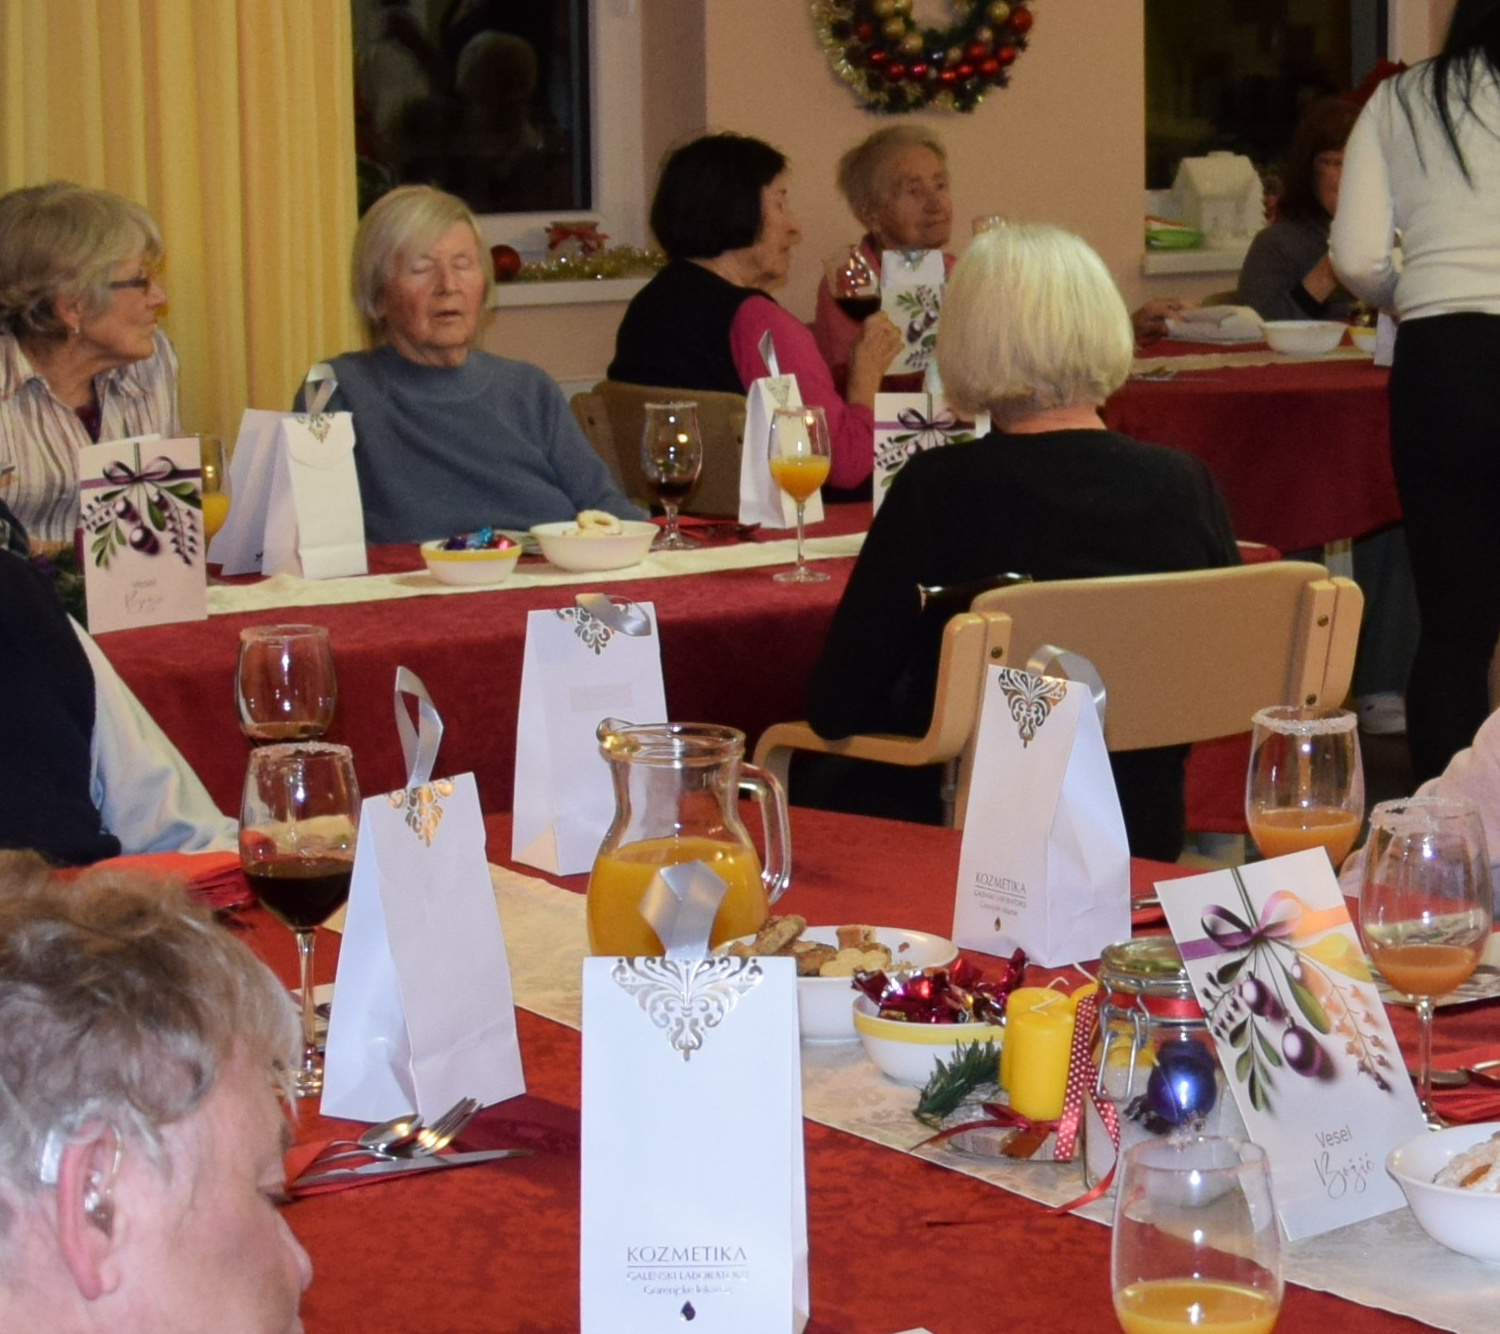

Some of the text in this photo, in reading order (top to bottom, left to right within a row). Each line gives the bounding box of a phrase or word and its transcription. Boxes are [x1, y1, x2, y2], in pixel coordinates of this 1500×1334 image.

[975, 871, 1027, 894] KOZMETIKA
[1315, 1124, 1353, 1148] Vesel
[627, 1246, 748, 1262] KOZMETIKA
